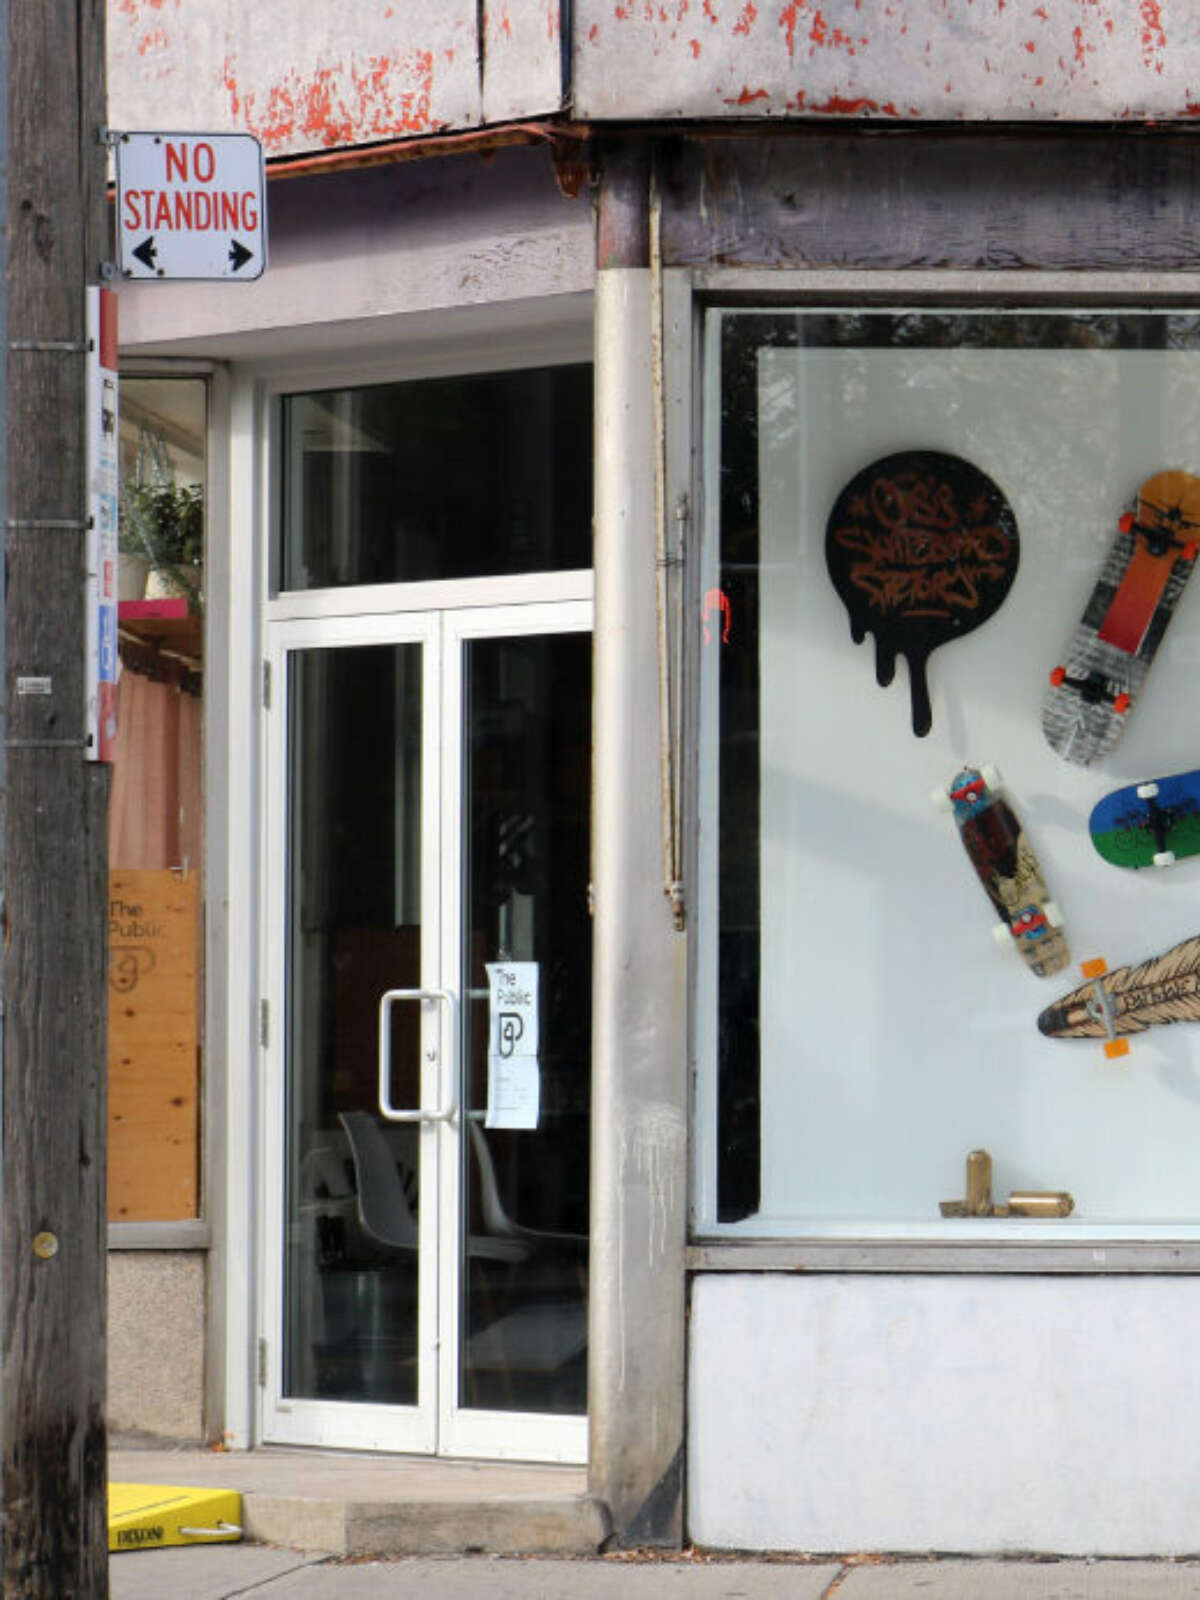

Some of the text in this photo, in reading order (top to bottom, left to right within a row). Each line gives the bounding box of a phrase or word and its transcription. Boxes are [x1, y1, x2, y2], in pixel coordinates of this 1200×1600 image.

[165, 142, 215, 183] NO
[124, 189, 257, 231] STANDING
[110, 900, 143, 918] The
[108, 920, 168, 938] Public
[494, 968, 517, 986] The
[497, 988, 532, 1006] Public
